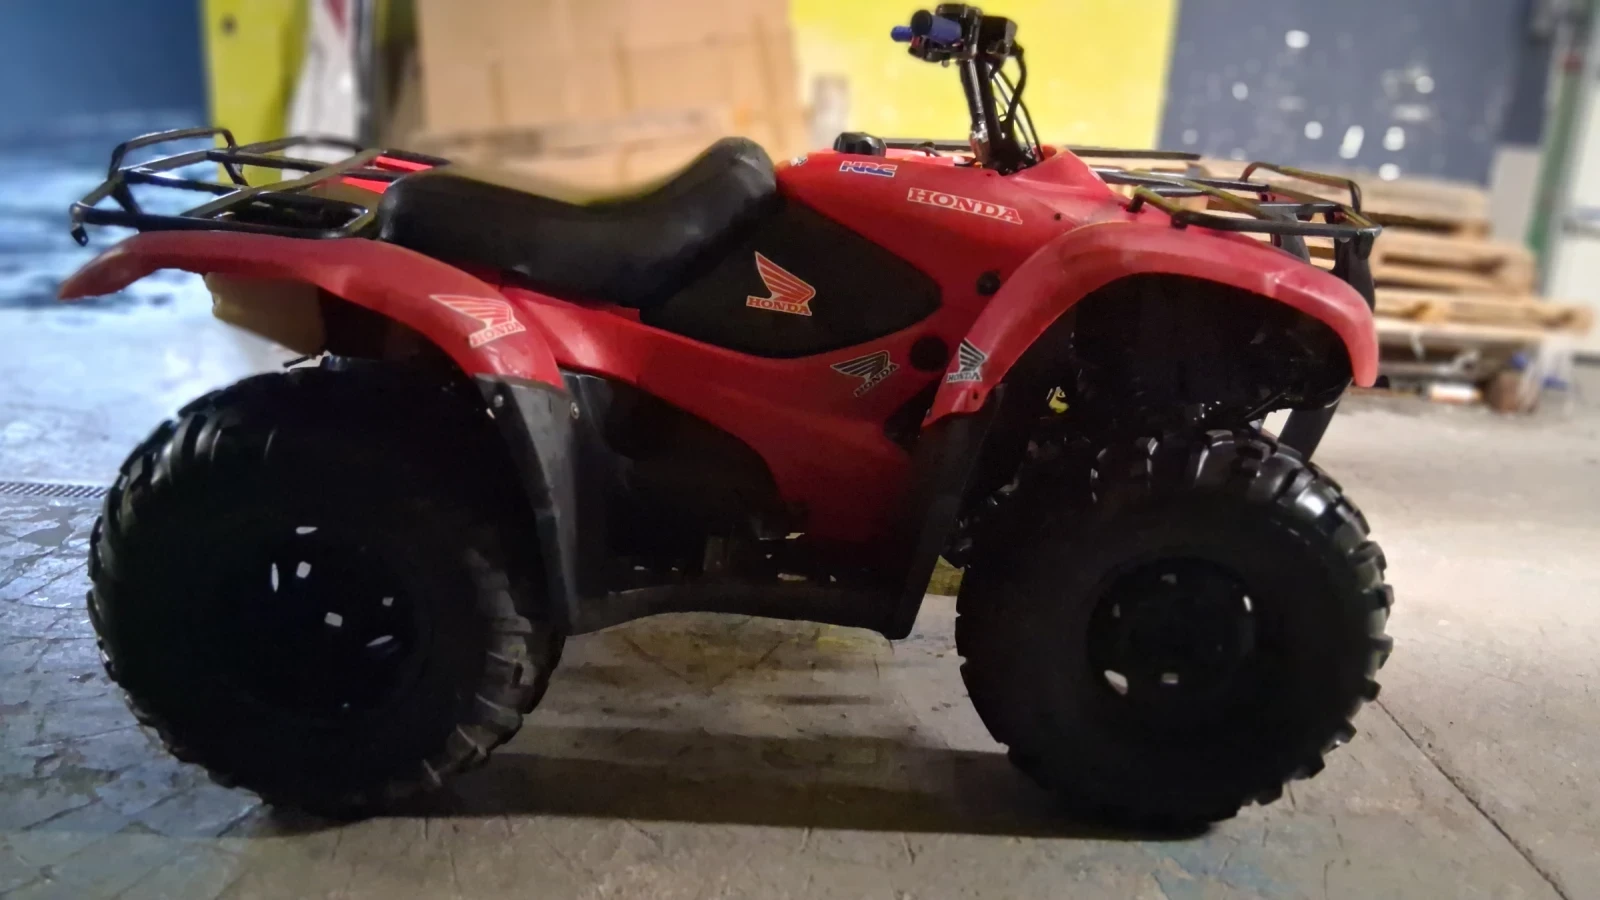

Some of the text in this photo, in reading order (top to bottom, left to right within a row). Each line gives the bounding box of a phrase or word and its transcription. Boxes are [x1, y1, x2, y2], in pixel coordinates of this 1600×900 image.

[840, 160, 898, 177] HRC
[908, 188, 1023, 224] HONDA
[747, 296, 812, 316] HONDA
[470, 321, 525, 347] HONDA
[854, 364, 899, 397] HONDA
[948, 371, 981, 383] HONDA
